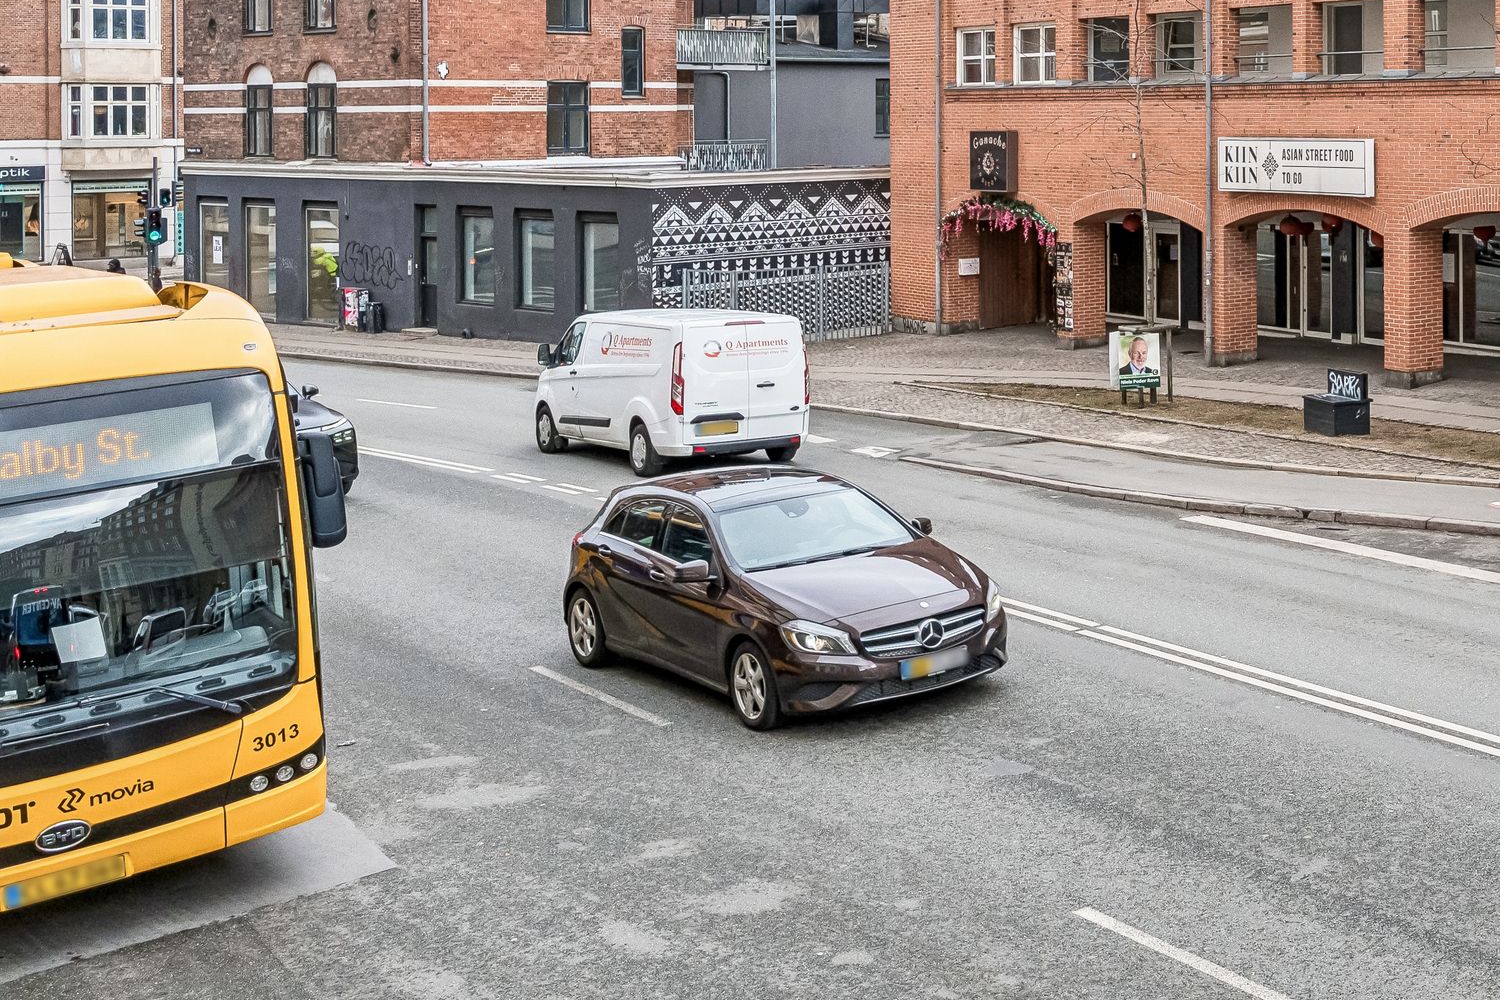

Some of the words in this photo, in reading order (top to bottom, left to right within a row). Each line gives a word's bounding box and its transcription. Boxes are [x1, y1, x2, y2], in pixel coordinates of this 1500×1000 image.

[972, 135, 1007, 150] Ganache
[1224, 145, 1258, 164] KIIN
[1281, 148, 1303, 161] ASIAN
[1305, 149, 1332, 162] STREET
[1334, 149, 1354, 163] FOOD
[1224, 165, 1258, 184] KIIN
[1281, 171, 1291, 184] TO
[1292, 171, 1303, 185] GO
[613, 334, 619, 348] Q
[618, 335, 653, 348] Apartments
[725, 341, 733, 351] Q
[735, 338, 789, 350] Apartments
[97, 427, 149, 465] St.
[252, 723, 301, 752] 3013
[89, 778, 155, 807] movia
[42, 826, 85, 847] BYD
